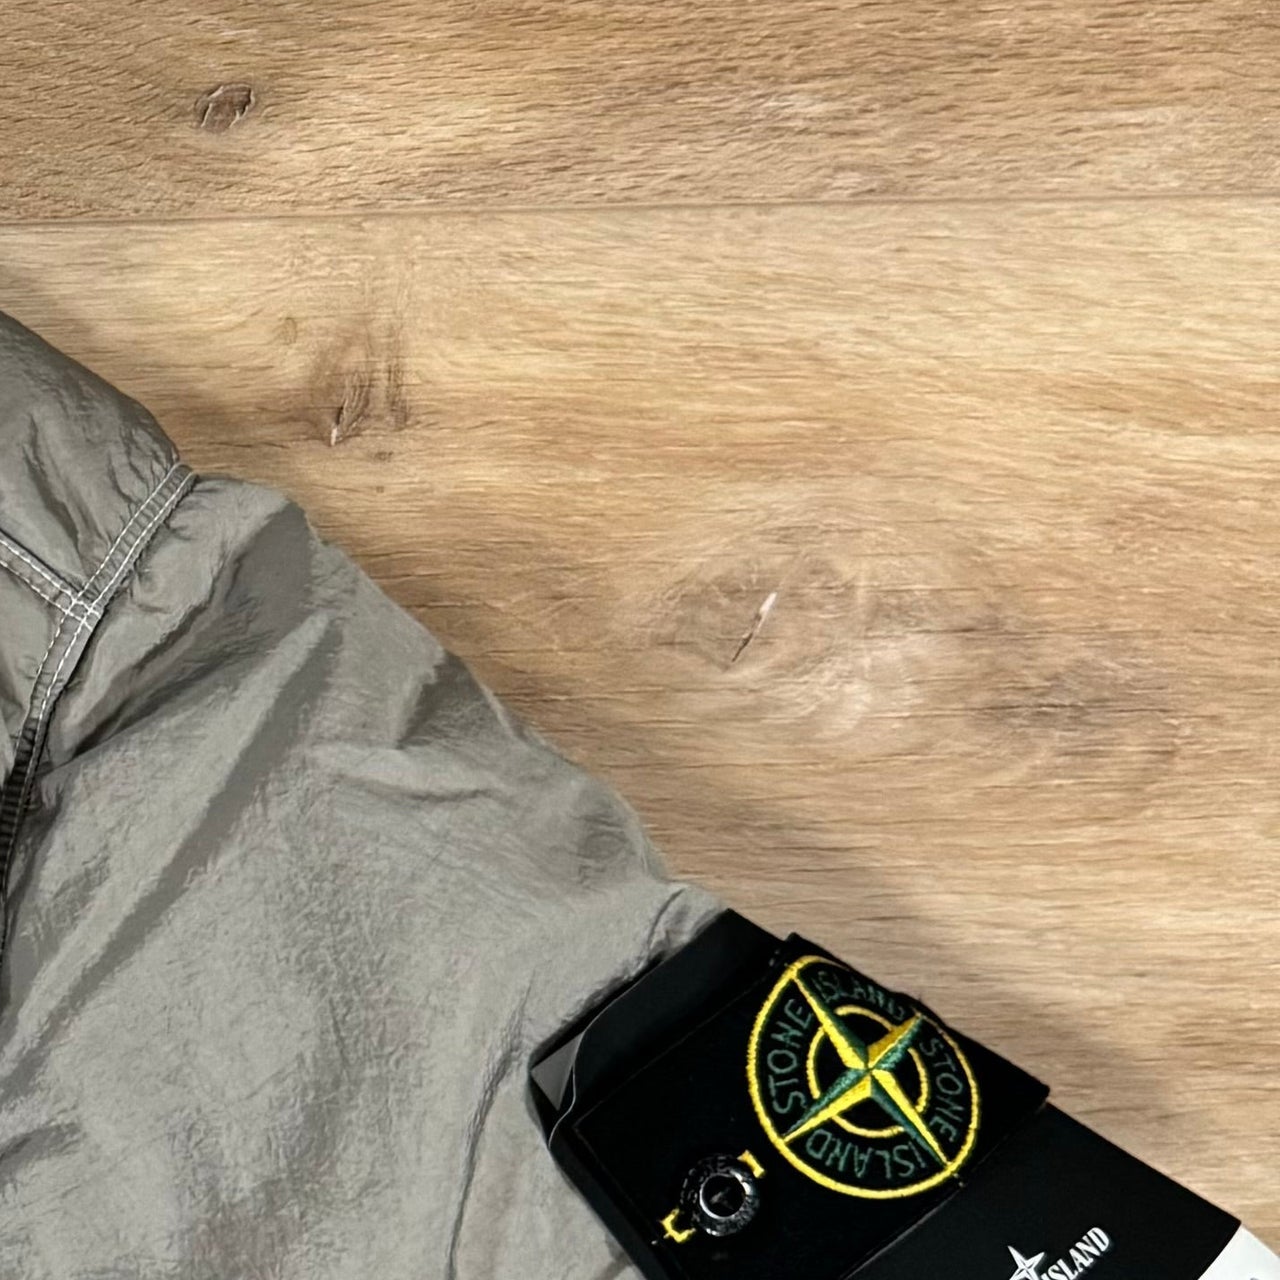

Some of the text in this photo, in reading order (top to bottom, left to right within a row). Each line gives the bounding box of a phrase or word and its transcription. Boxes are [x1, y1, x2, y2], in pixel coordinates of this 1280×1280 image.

[767, 999, 814, 1115] STONE
[918, 1038, 967, 1142] STONE
[805, 1128, 928, 1179] ISLAND
